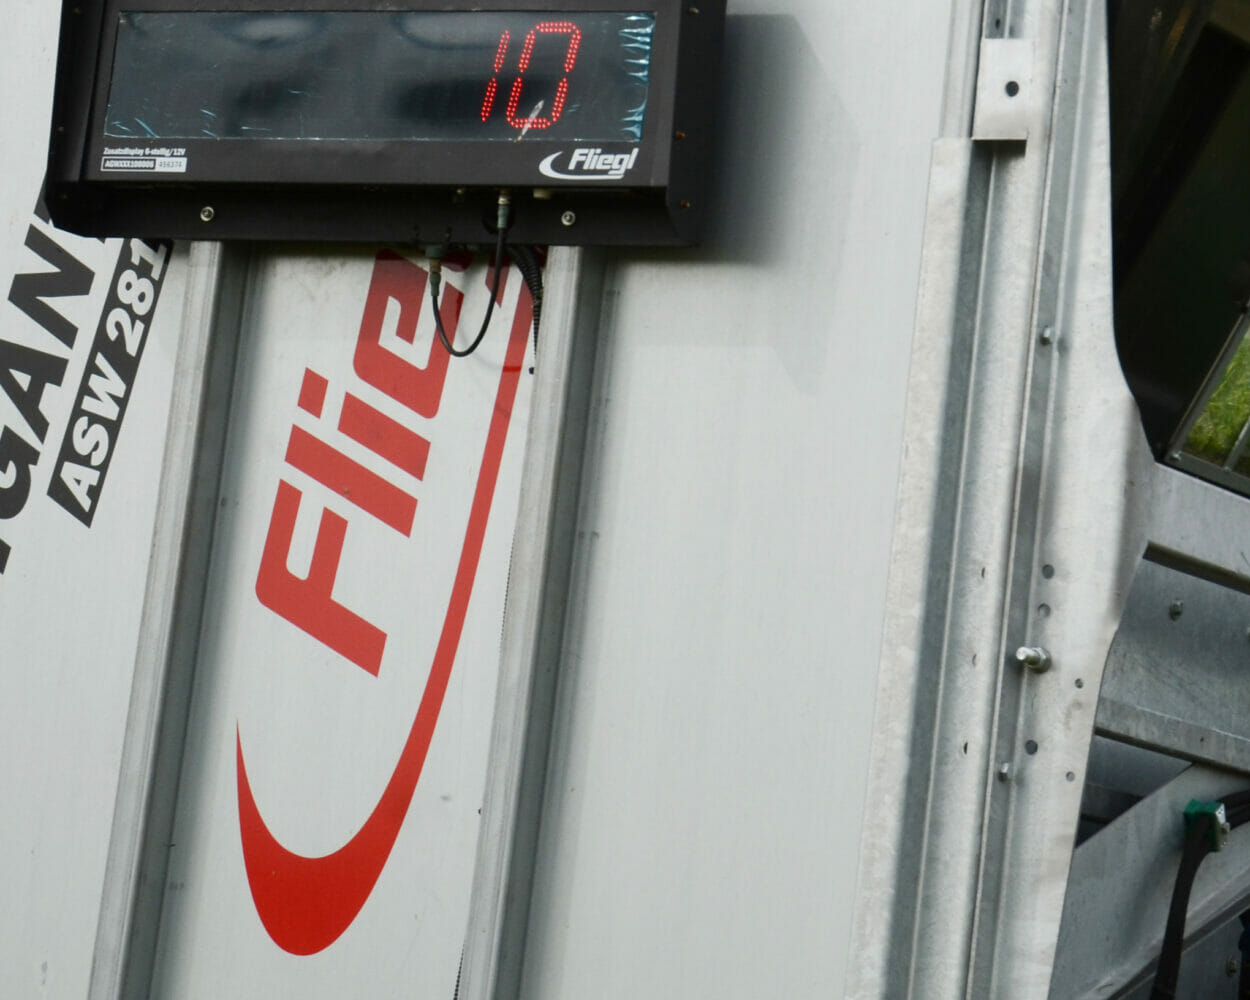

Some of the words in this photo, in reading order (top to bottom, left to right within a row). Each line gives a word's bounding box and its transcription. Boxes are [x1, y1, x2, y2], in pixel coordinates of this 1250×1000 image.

[481, 21, 581, 128] 10
[567, 147, 639, 175] Fliegl
[59, 352, 126, 512] ASW
[106, 237, 168, 357] 281
[255, 248, 512, 678] Flie
